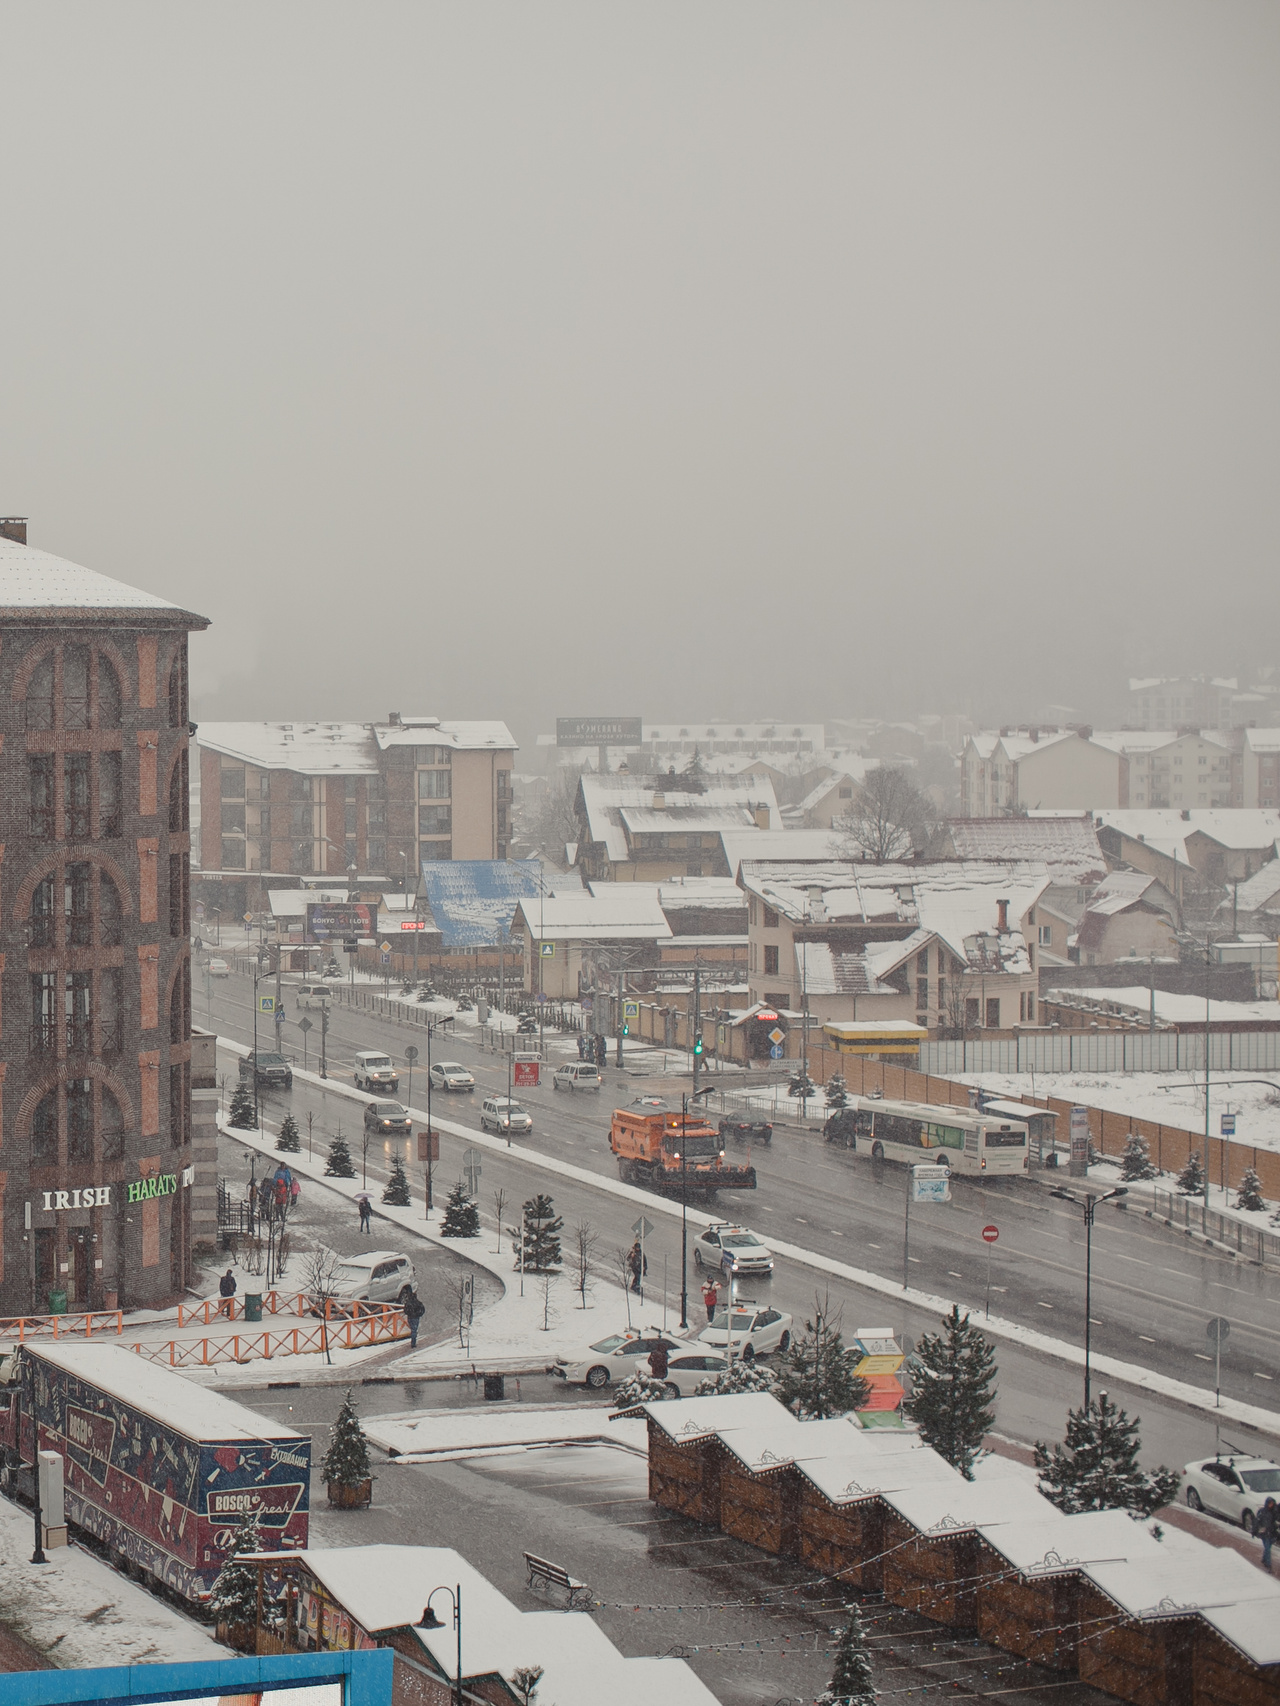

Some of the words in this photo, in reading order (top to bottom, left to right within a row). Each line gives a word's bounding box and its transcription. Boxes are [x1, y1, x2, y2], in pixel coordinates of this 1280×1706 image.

[42, 1186, 111, 1210] IRISH
[127, 1173, 177, 1203] HARAT'S
[215, 1494, 252, 1512] BOSCO
[251, 1501, 291, 1525] fresh
